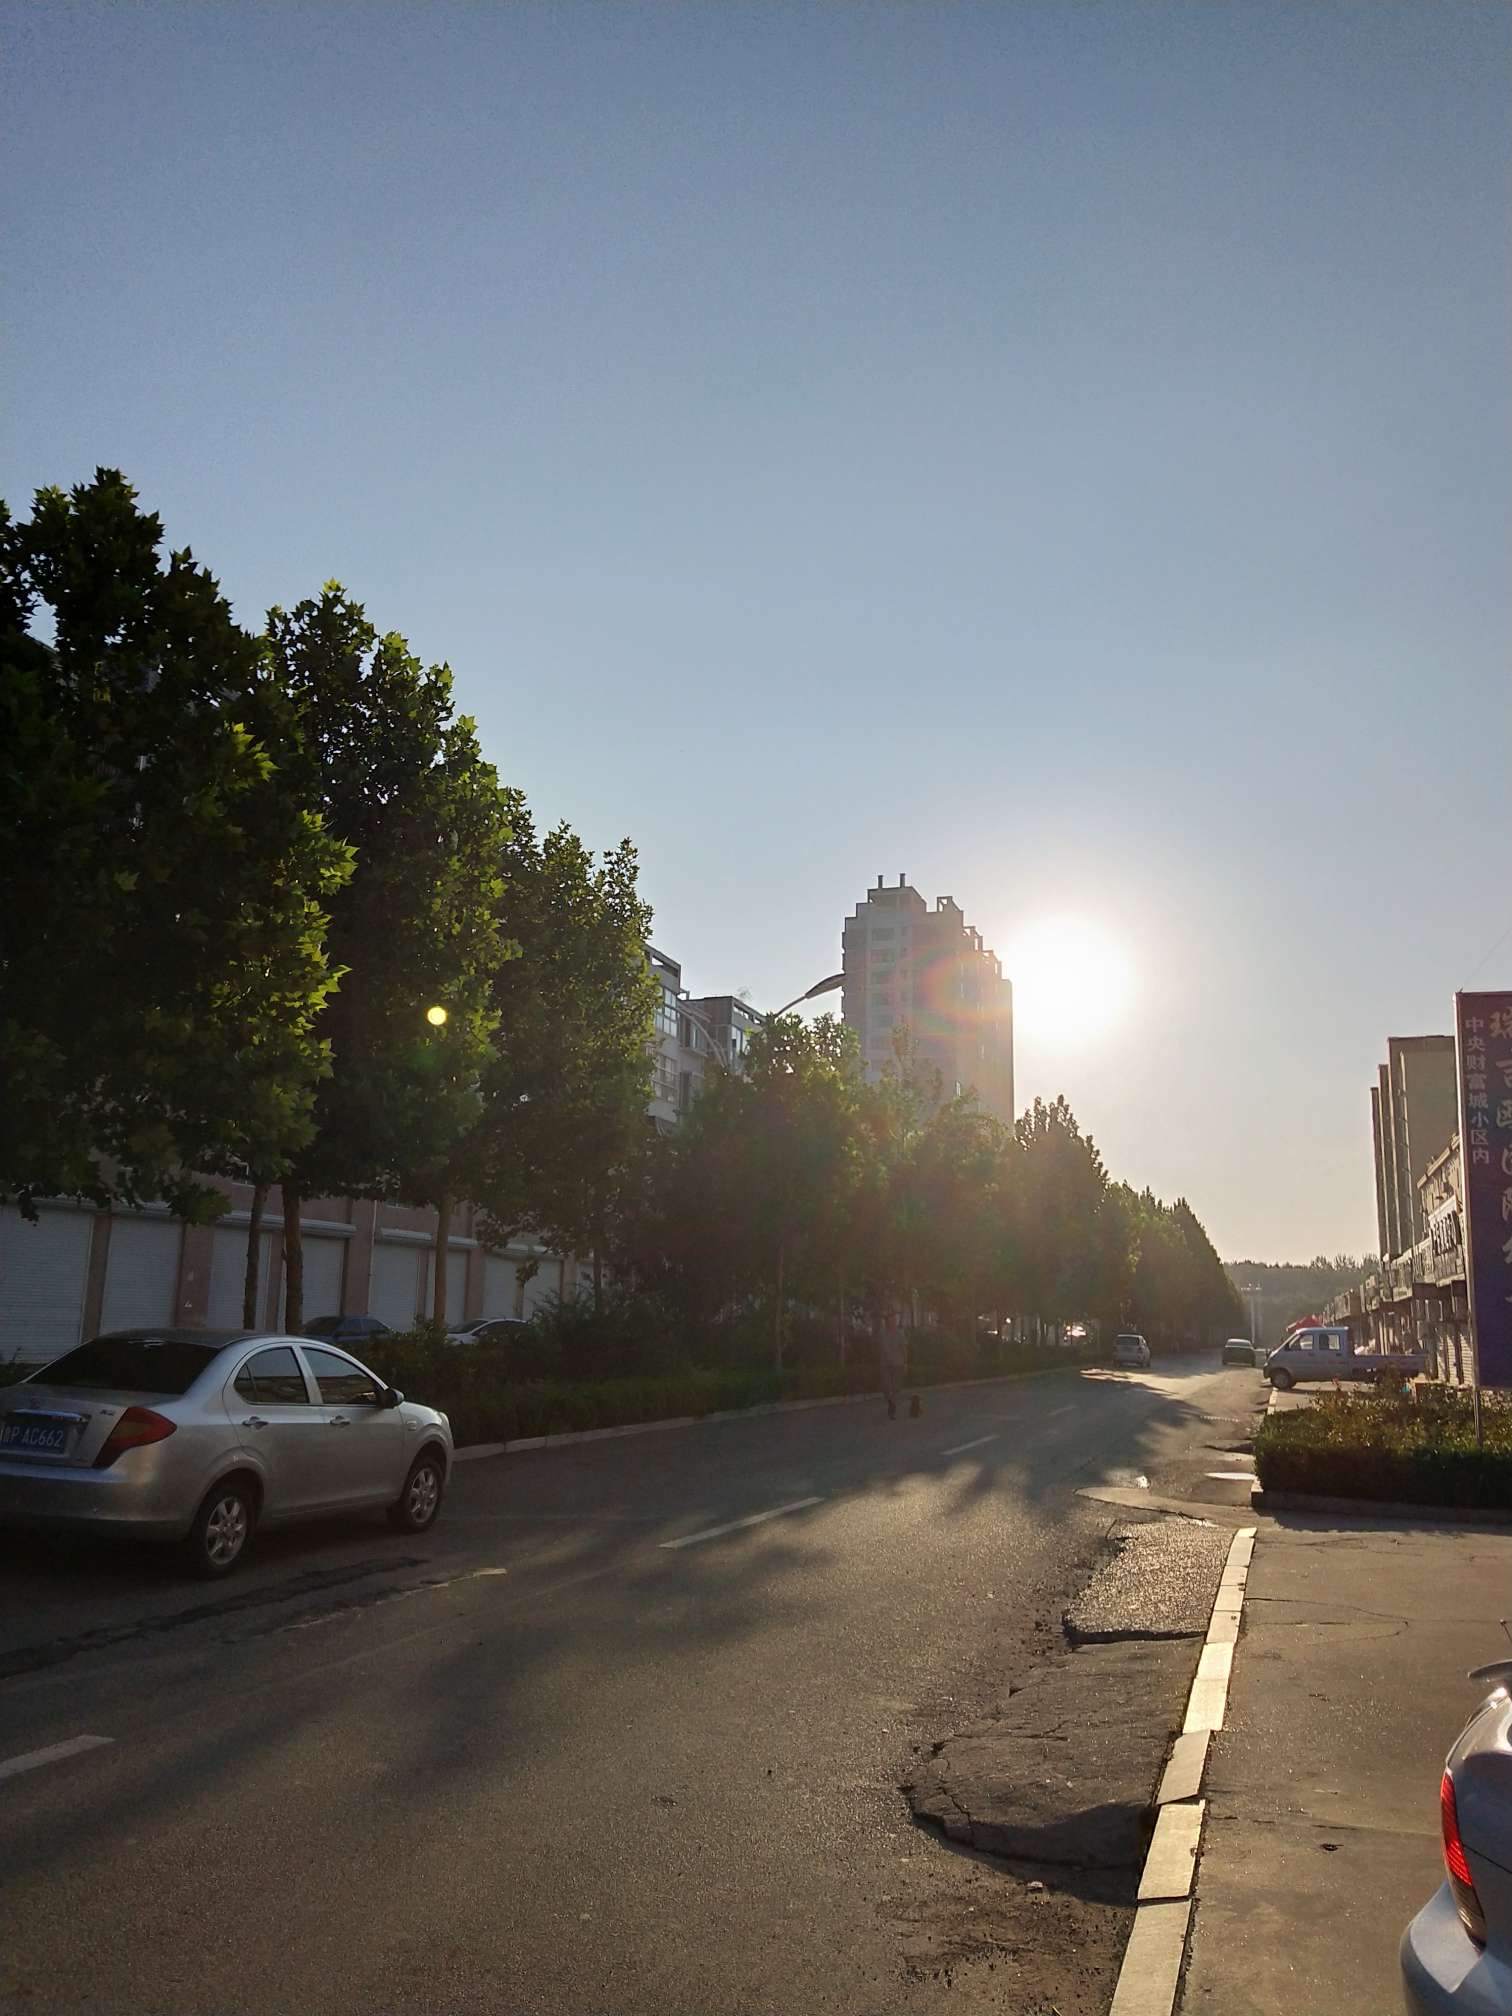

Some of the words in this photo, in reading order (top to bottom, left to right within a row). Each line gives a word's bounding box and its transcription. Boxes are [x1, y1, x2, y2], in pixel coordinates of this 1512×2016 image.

[1465, 1016, 1489, 1165] 中央财富城小区内
